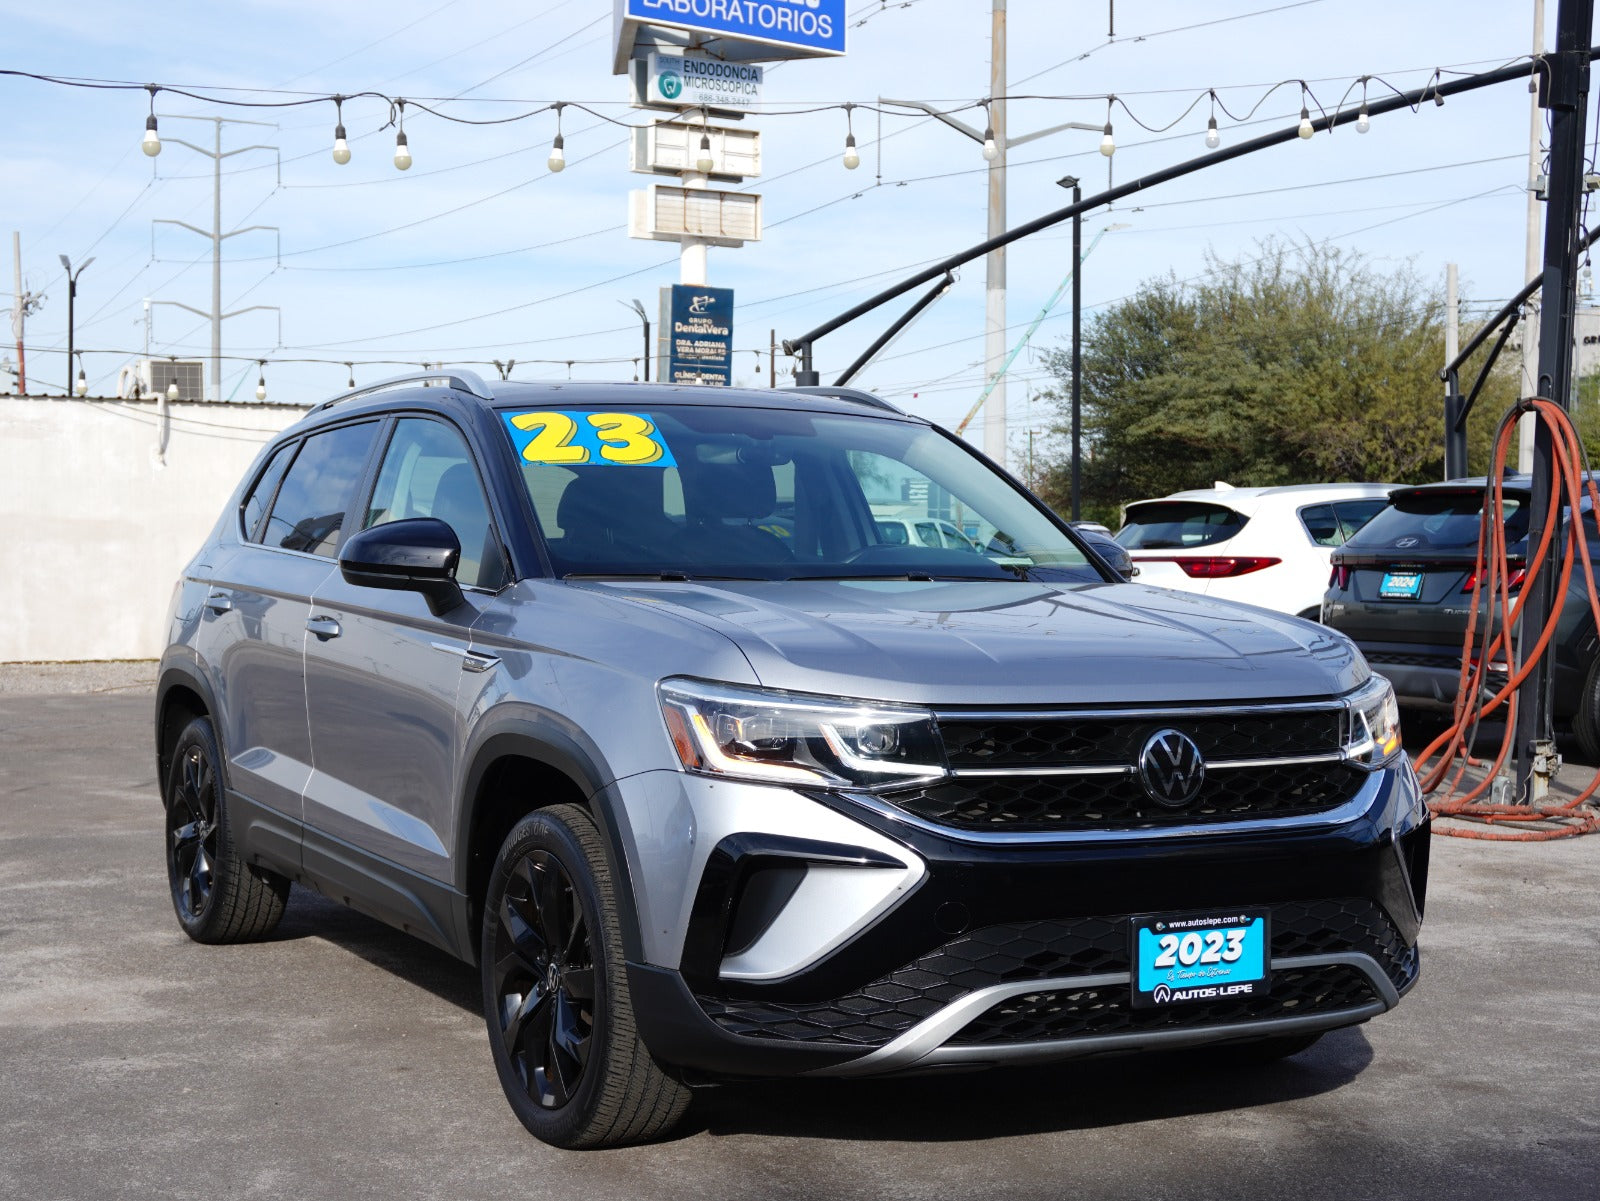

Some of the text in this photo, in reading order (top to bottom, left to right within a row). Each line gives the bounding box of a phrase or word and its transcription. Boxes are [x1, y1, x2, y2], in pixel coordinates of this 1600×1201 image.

[684, 60, 759, 82] ENDODONCIA
[684, 75, 758, 96] MICROSCOPICA
[675, 322, 729, 335] DentalVera
[1387, 575, 1417, 588] 2024
[1168, 916, 1239, 929] www.autoslepe.com
[1154, 929, 1247, 967] 2023
